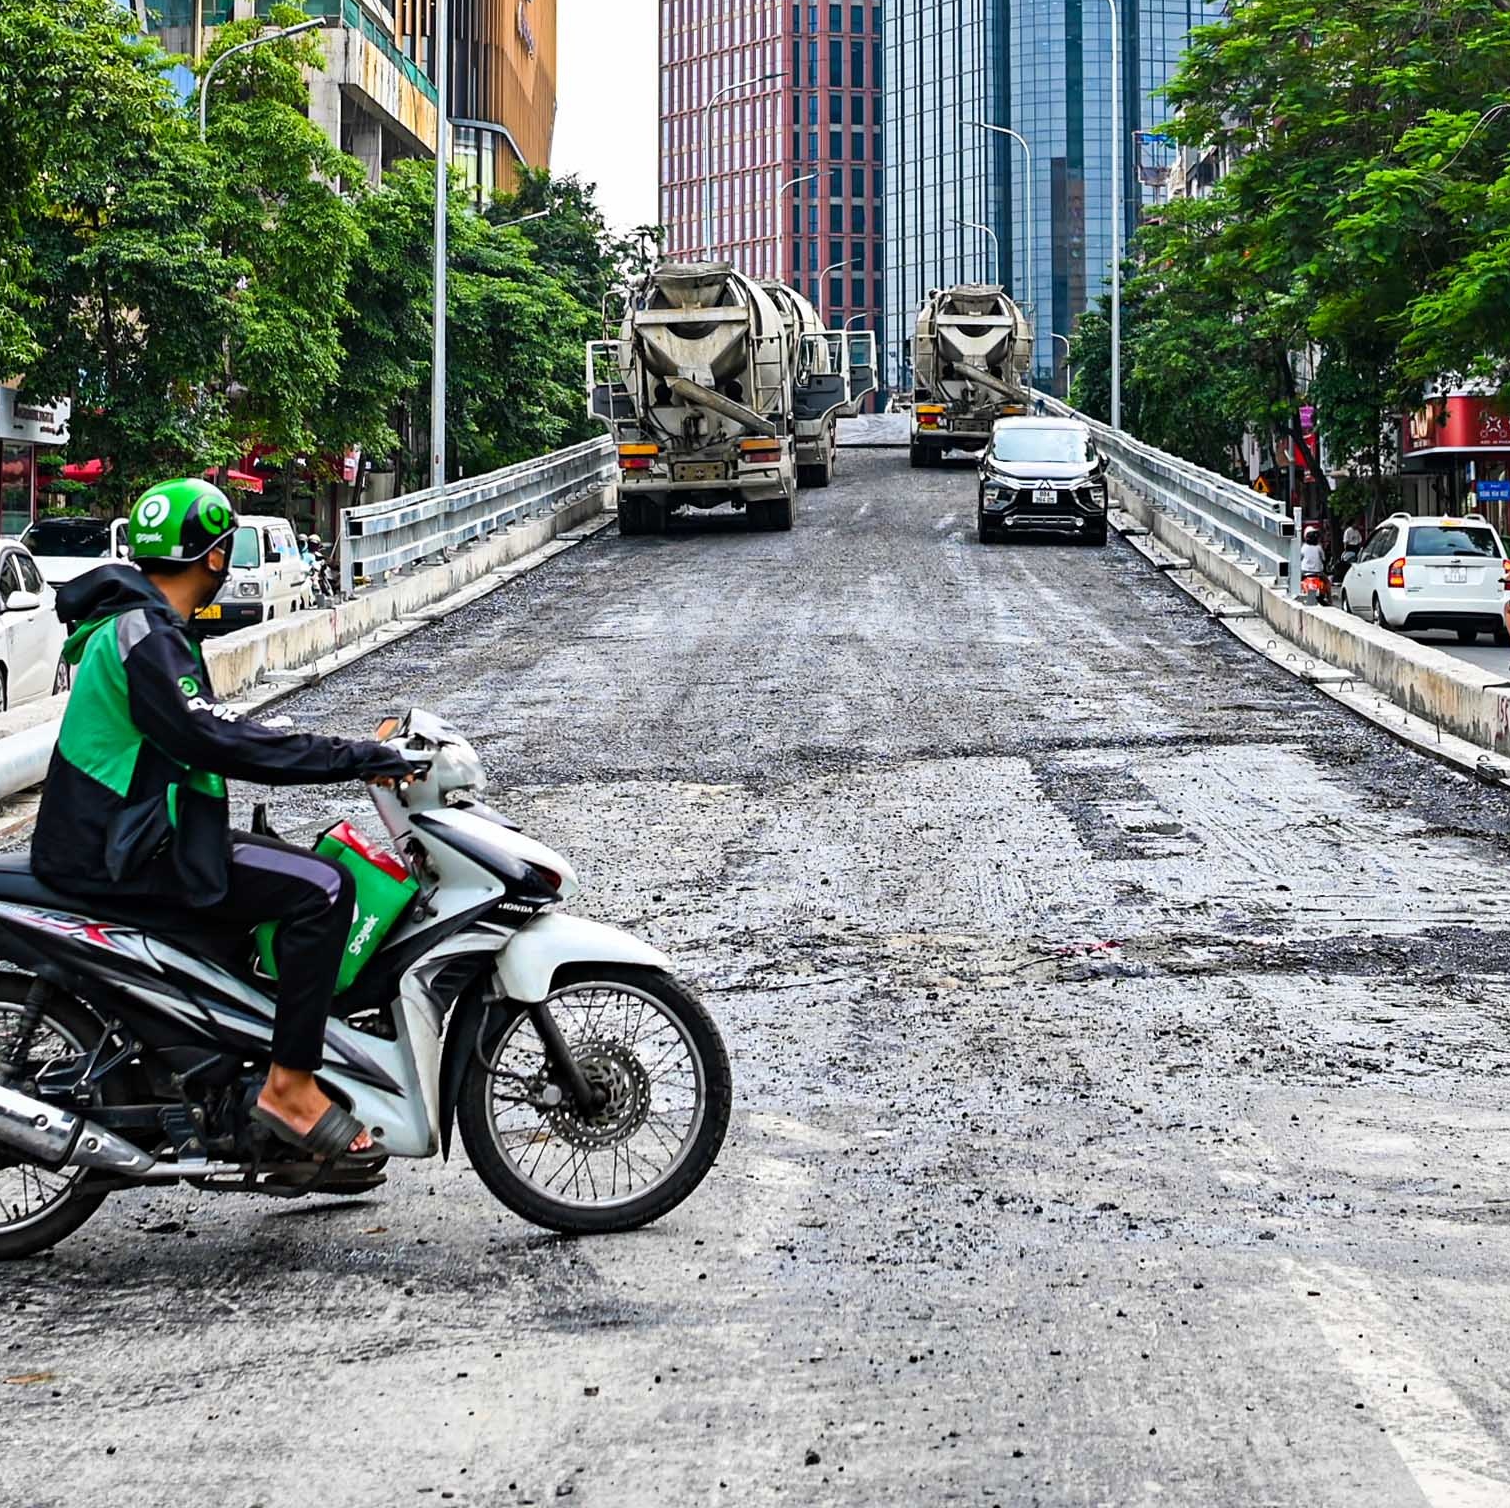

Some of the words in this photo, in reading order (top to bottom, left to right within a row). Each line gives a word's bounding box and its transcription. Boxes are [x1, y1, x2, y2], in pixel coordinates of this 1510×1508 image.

[135, 532, 163, 544] gojek
[498, 903, 533, 914] HONDA
[348, 914, 380, 956] gojek
